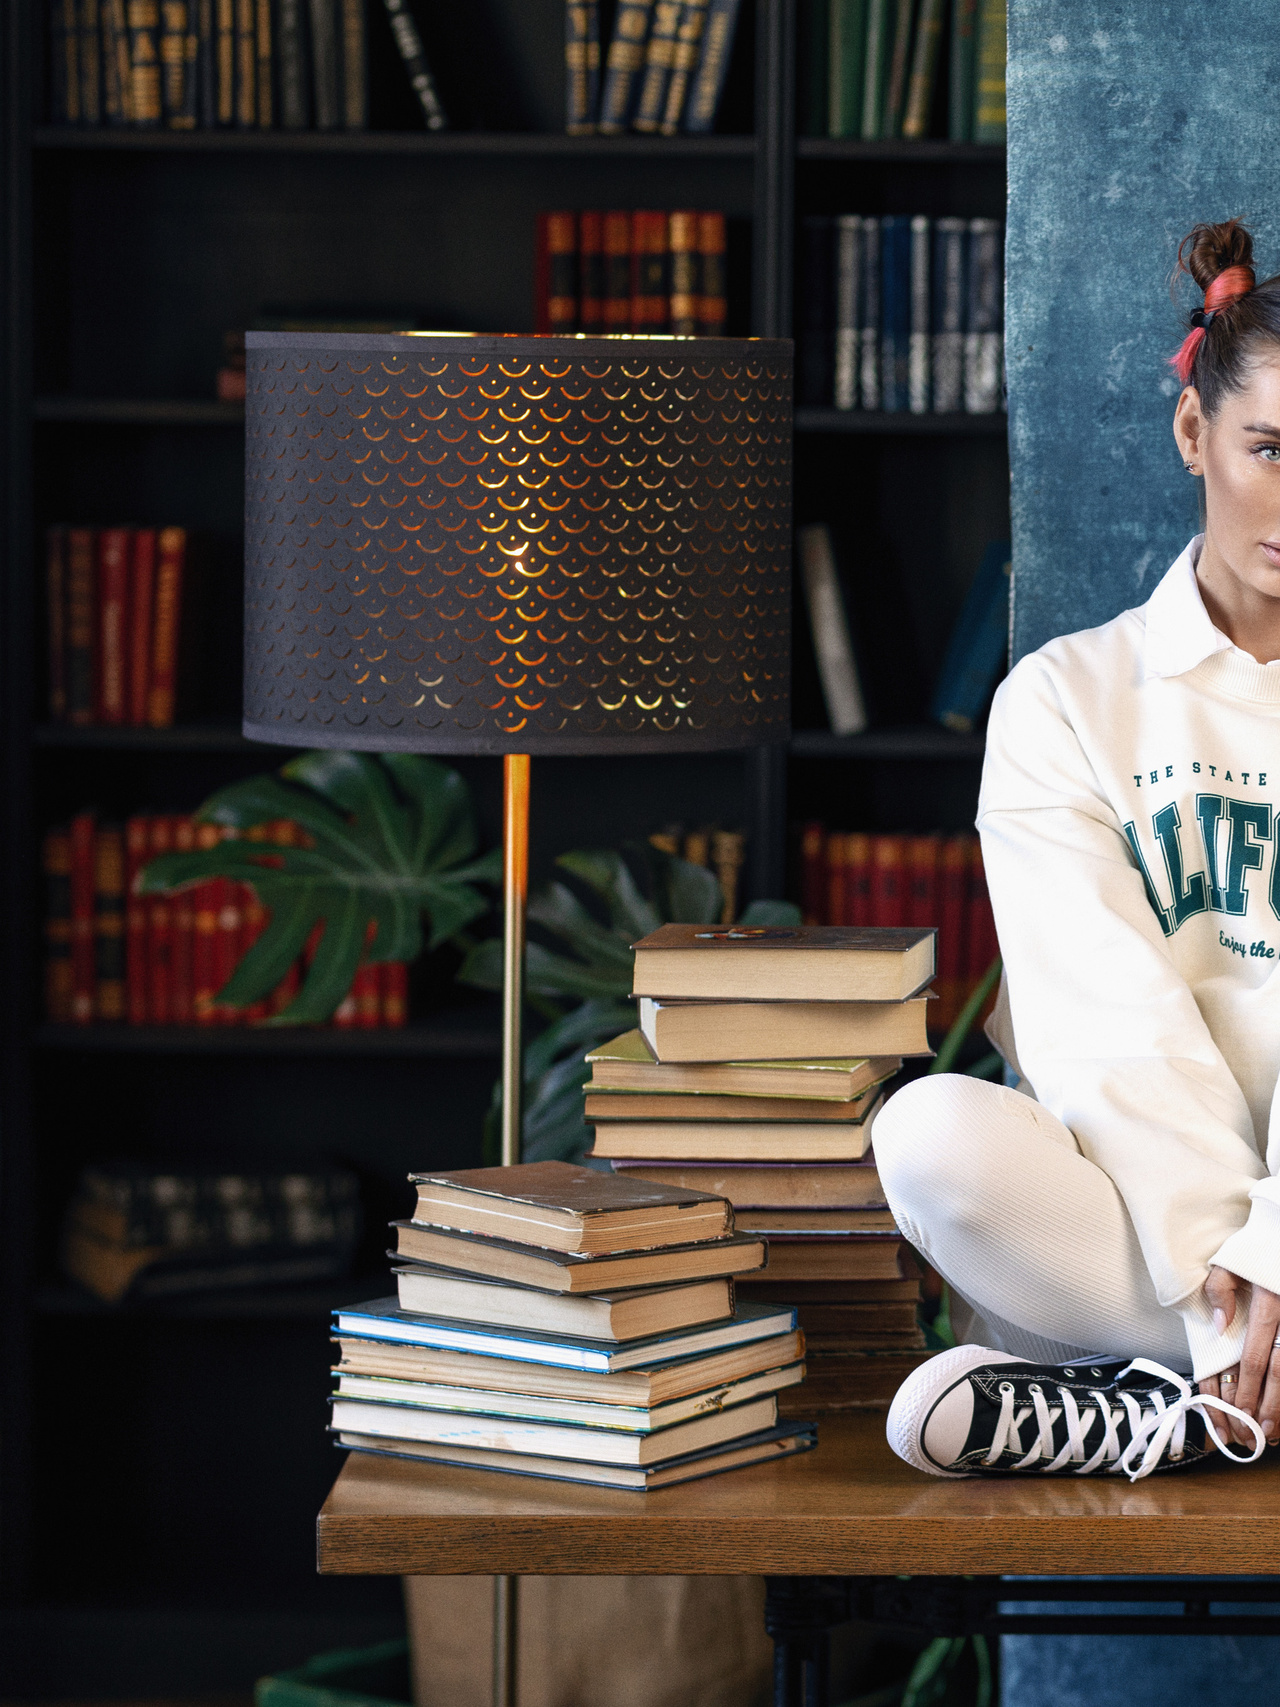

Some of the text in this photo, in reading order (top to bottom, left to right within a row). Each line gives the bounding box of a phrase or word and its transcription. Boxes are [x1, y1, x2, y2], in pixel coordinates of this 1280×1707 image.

[1133, 764, 1174, 788] THE
[1192, 761, 1267, 786] STATE
[1219, 930, 1276, 959] Enjoy the
